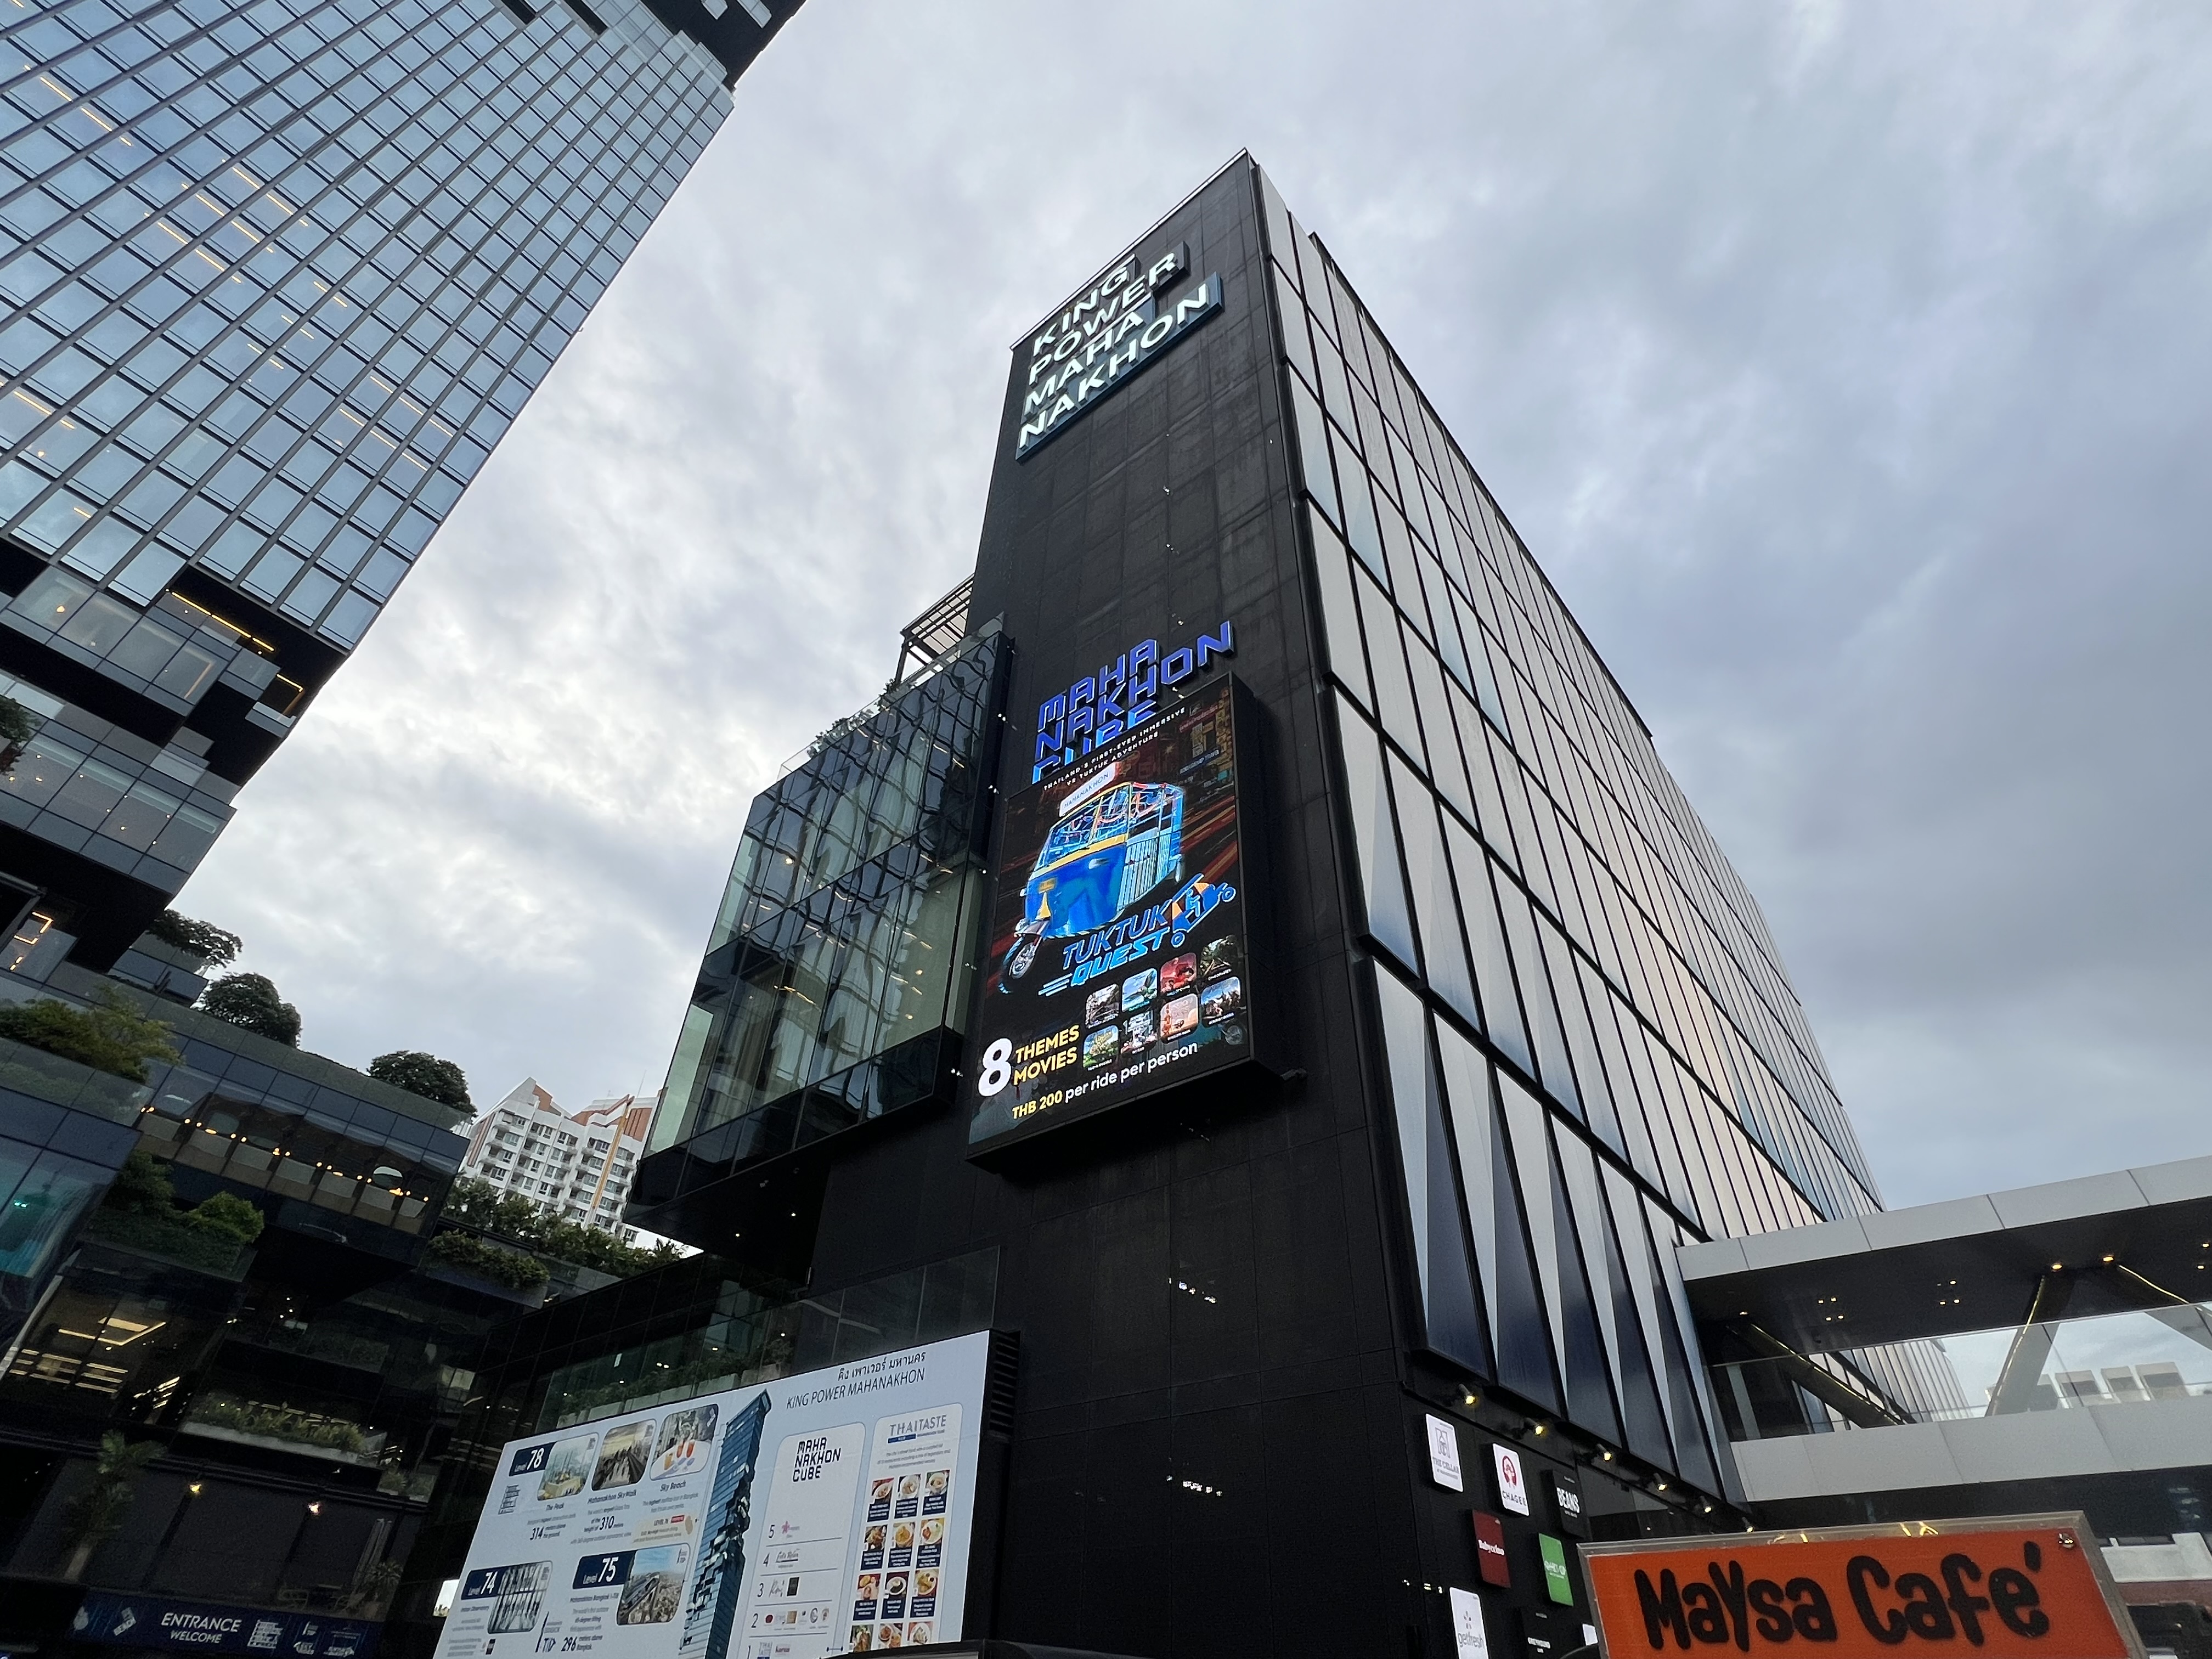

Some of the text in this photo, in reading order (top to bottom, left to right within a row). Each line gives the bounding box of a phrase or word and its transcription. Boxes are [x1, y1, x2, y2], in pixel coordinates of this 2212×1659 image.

[1029, 252, 1177, 385] POWER
[1033, 267, 1129, 356] KING
[1019, 284, 1209, 450] NAKHON
[1024, 312, 1146, 416] MAHA
[1035, 620, 1234, 762] NAKHON
[1037, 639, 1159, 732] MAHA
[1063, 899, 1174, 969] TUKTUK
[1070, 927, 1171, 987] QUEST
[1015, 1025, 1080, 1064] THEMES
[978, 1037, 1012, 1097] 8
[1013, 1047, 1077, 1086] MOVIES
[1012, 1100, 1037, 1120] THB
[1039, 1090, 1063, 1110] 200
[1065, 1082, 1090, 1103] per
[1091, 1069, 1118, 1092] ride
[1120, 1060, 1146, 1081] per
[1147, 1041, 1198, 1073] person
[786, 1367, 926, 1410] KING POWER MAHANAKHON
[527, 1447, 545, 1471] 78
[795, 1448, 842, 1469] NAKHON
[797, 1437, 827, 1455] MAHA
[792, 1465, 822, 1482] CUBE
[1502, 1490, 1527, 1506] CHAGEE
[1556, 1486, 1581, 1514] BEANS
[530, 1527, 544, 1541] 314
[599, 1516, 615, 1531] 310
[768, 1525, 776, 1538] 5
[583, 1556, 619, 1585] Level 75
[763, 1553, 770, 1567] 4
[481, 1571, 498, 1595] 74
[757, 1583, 764, 1598] 3
[161, 1612, 242, 1633] ENTRANCE
[751, 1613, 759, 1628] 2
[170, 1630, 223, 1645] WELCOME
[561, 1637, 578, 1652] 296
